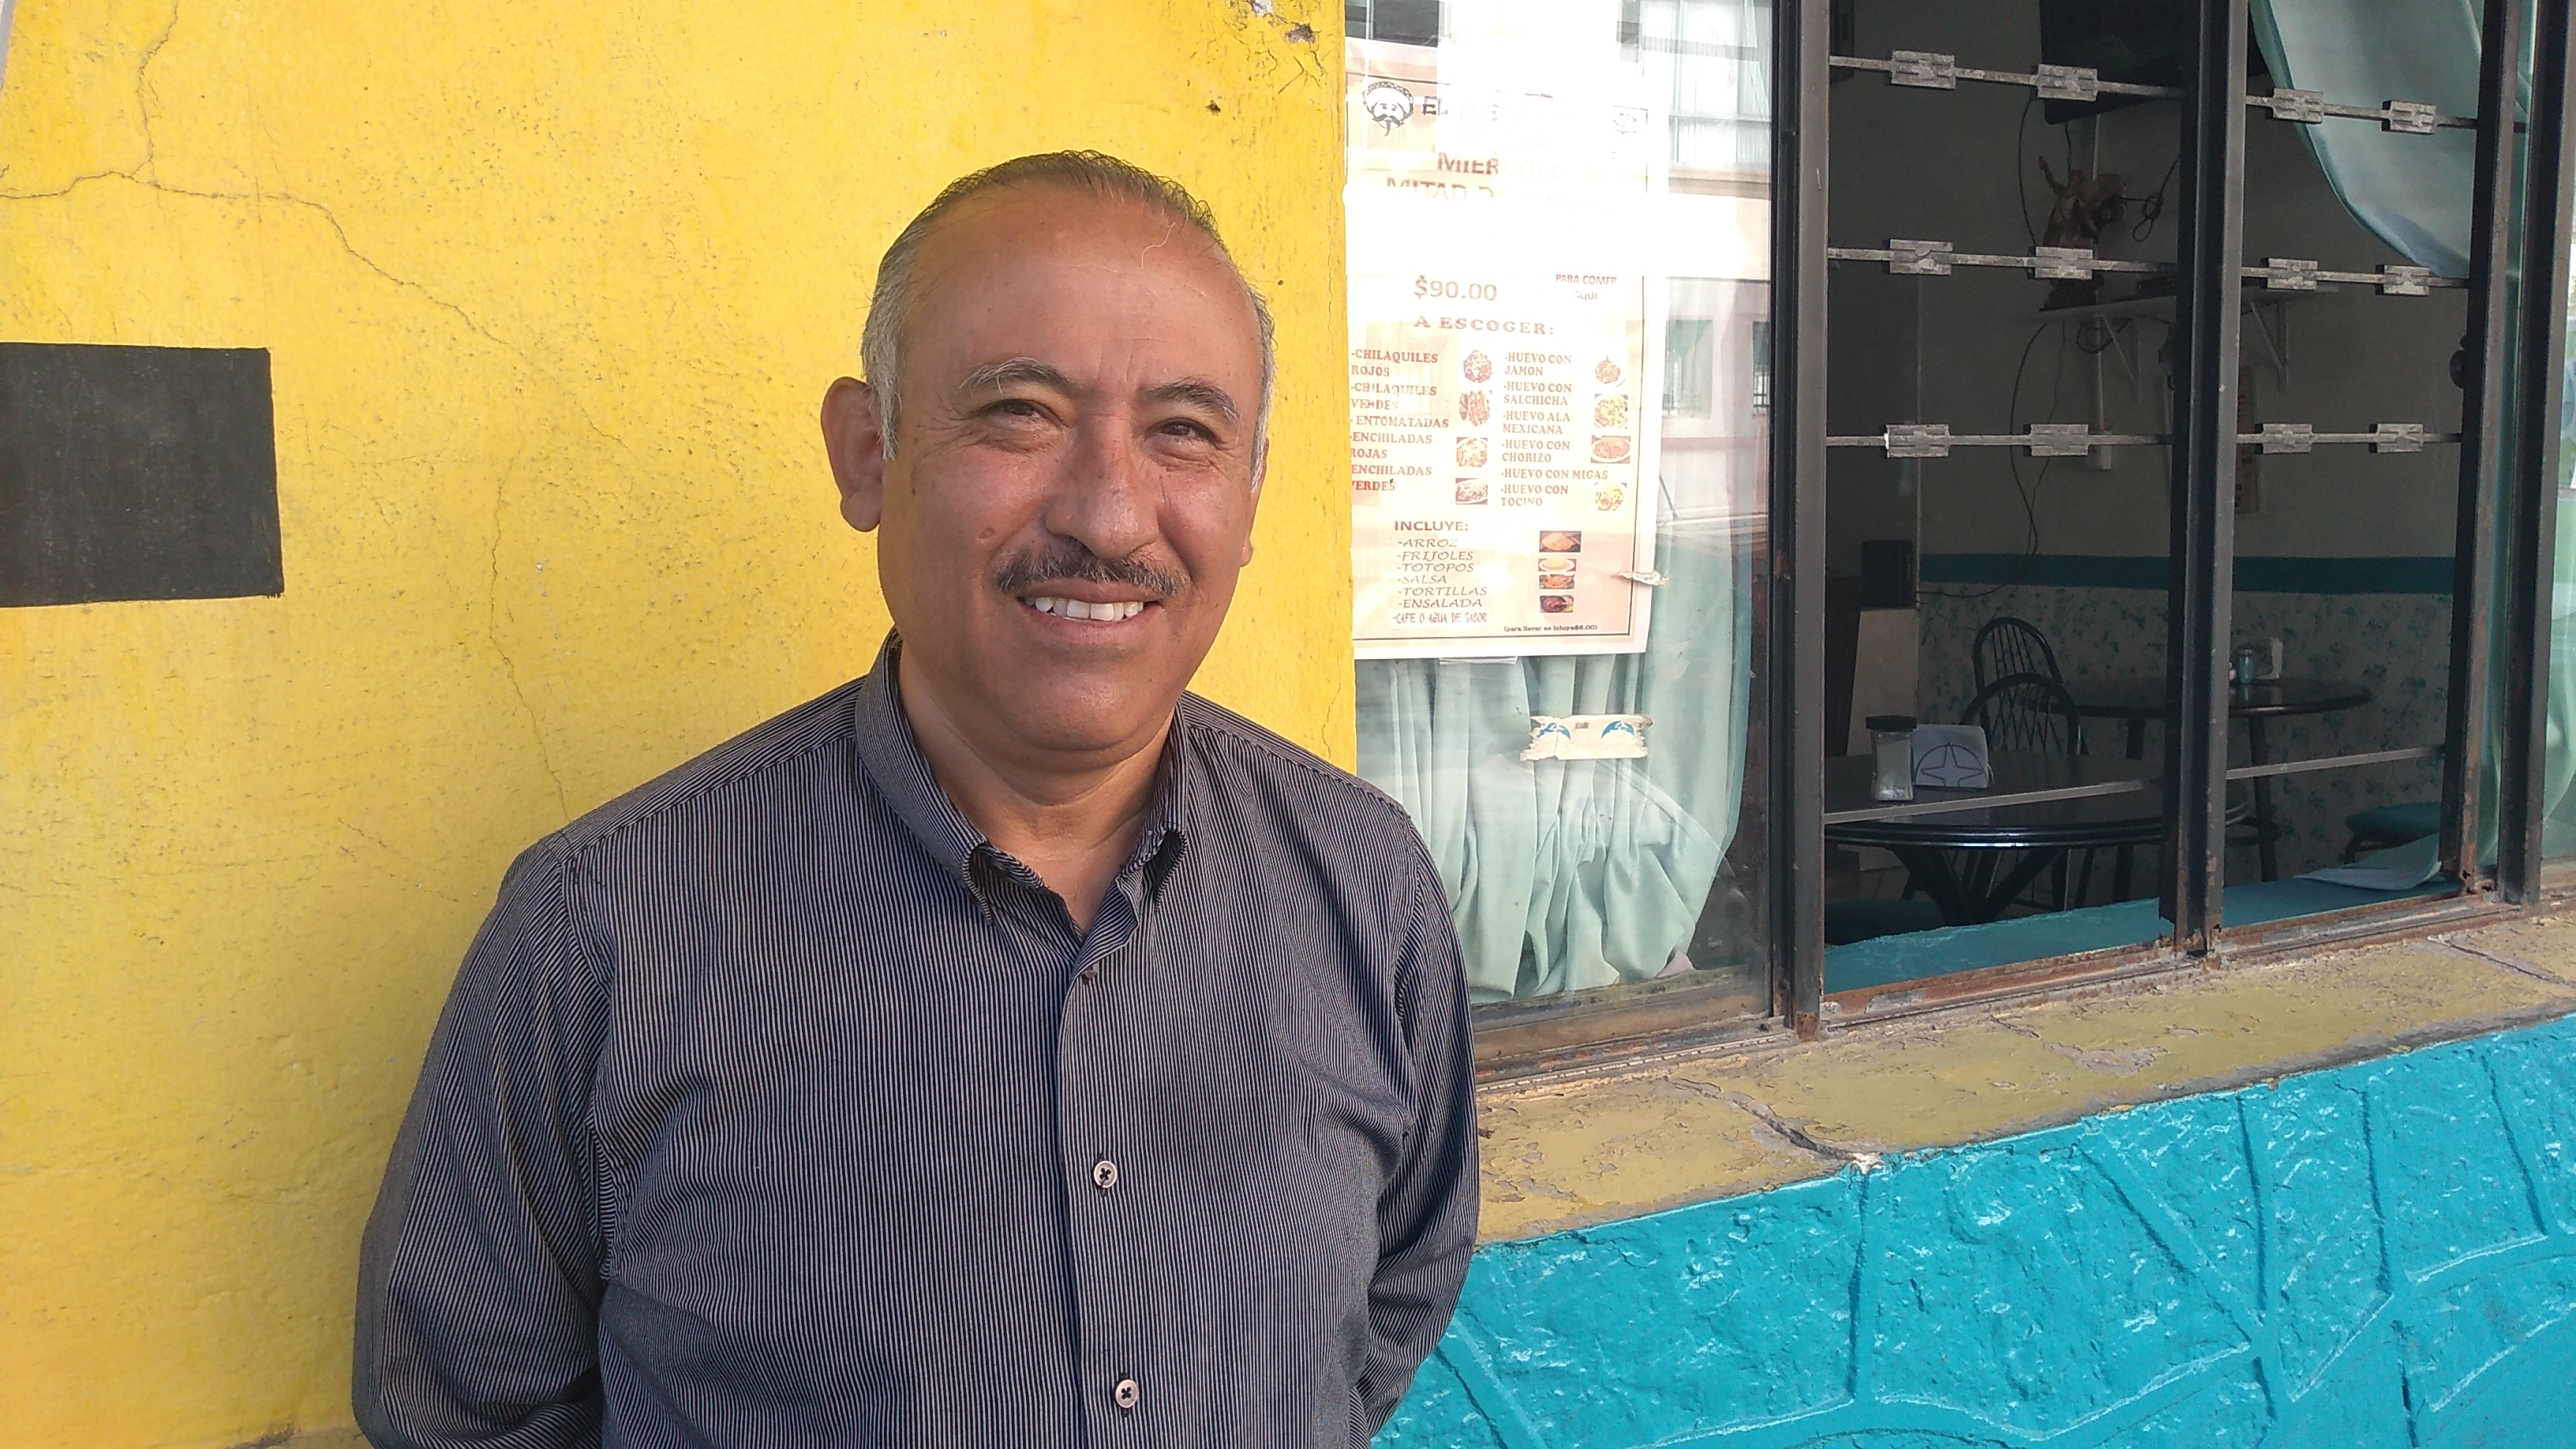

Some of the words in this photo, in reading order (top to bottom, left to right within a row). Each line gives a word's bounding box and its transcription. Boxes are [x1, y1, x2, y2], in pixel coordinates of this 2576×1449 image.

[1556, 274, 1579, 283] PARA
[1413, 275, 1497, 301] $90.00
[1414, 316, 1430, 328] A
[1439, 317, 1553, 335] ESCOGER:
[1351, 349, 1439, 364] -CHILAQUILES
[1548, 354, 1572, 365] CON
[1350, 365, 1390, 377] ROJOS
[1504, 365, 1544, 376] JAMON
[1548, 384, 1572, 393] CON
[1503, 395, 1569, 406] SALCHICHA
[1503, 423, 1563, 435] MEXICANA
[1546, 440, 1571, 451] CON
[1350, 447, 1388, 459] ROJAS
[1502, 452, 1552, 462] CHORIZO
[1350, 464, 1432, 476] ENCHILADAS
[1545, 469, 1570, 479] CON
[1572, 470, 1608, 480] MIGAS
[1544, 485, 1569, 495] CON
[1500, 497, 1543, 507] TOCINO
[1394, 520, 1469, 532] INCLUYE:
